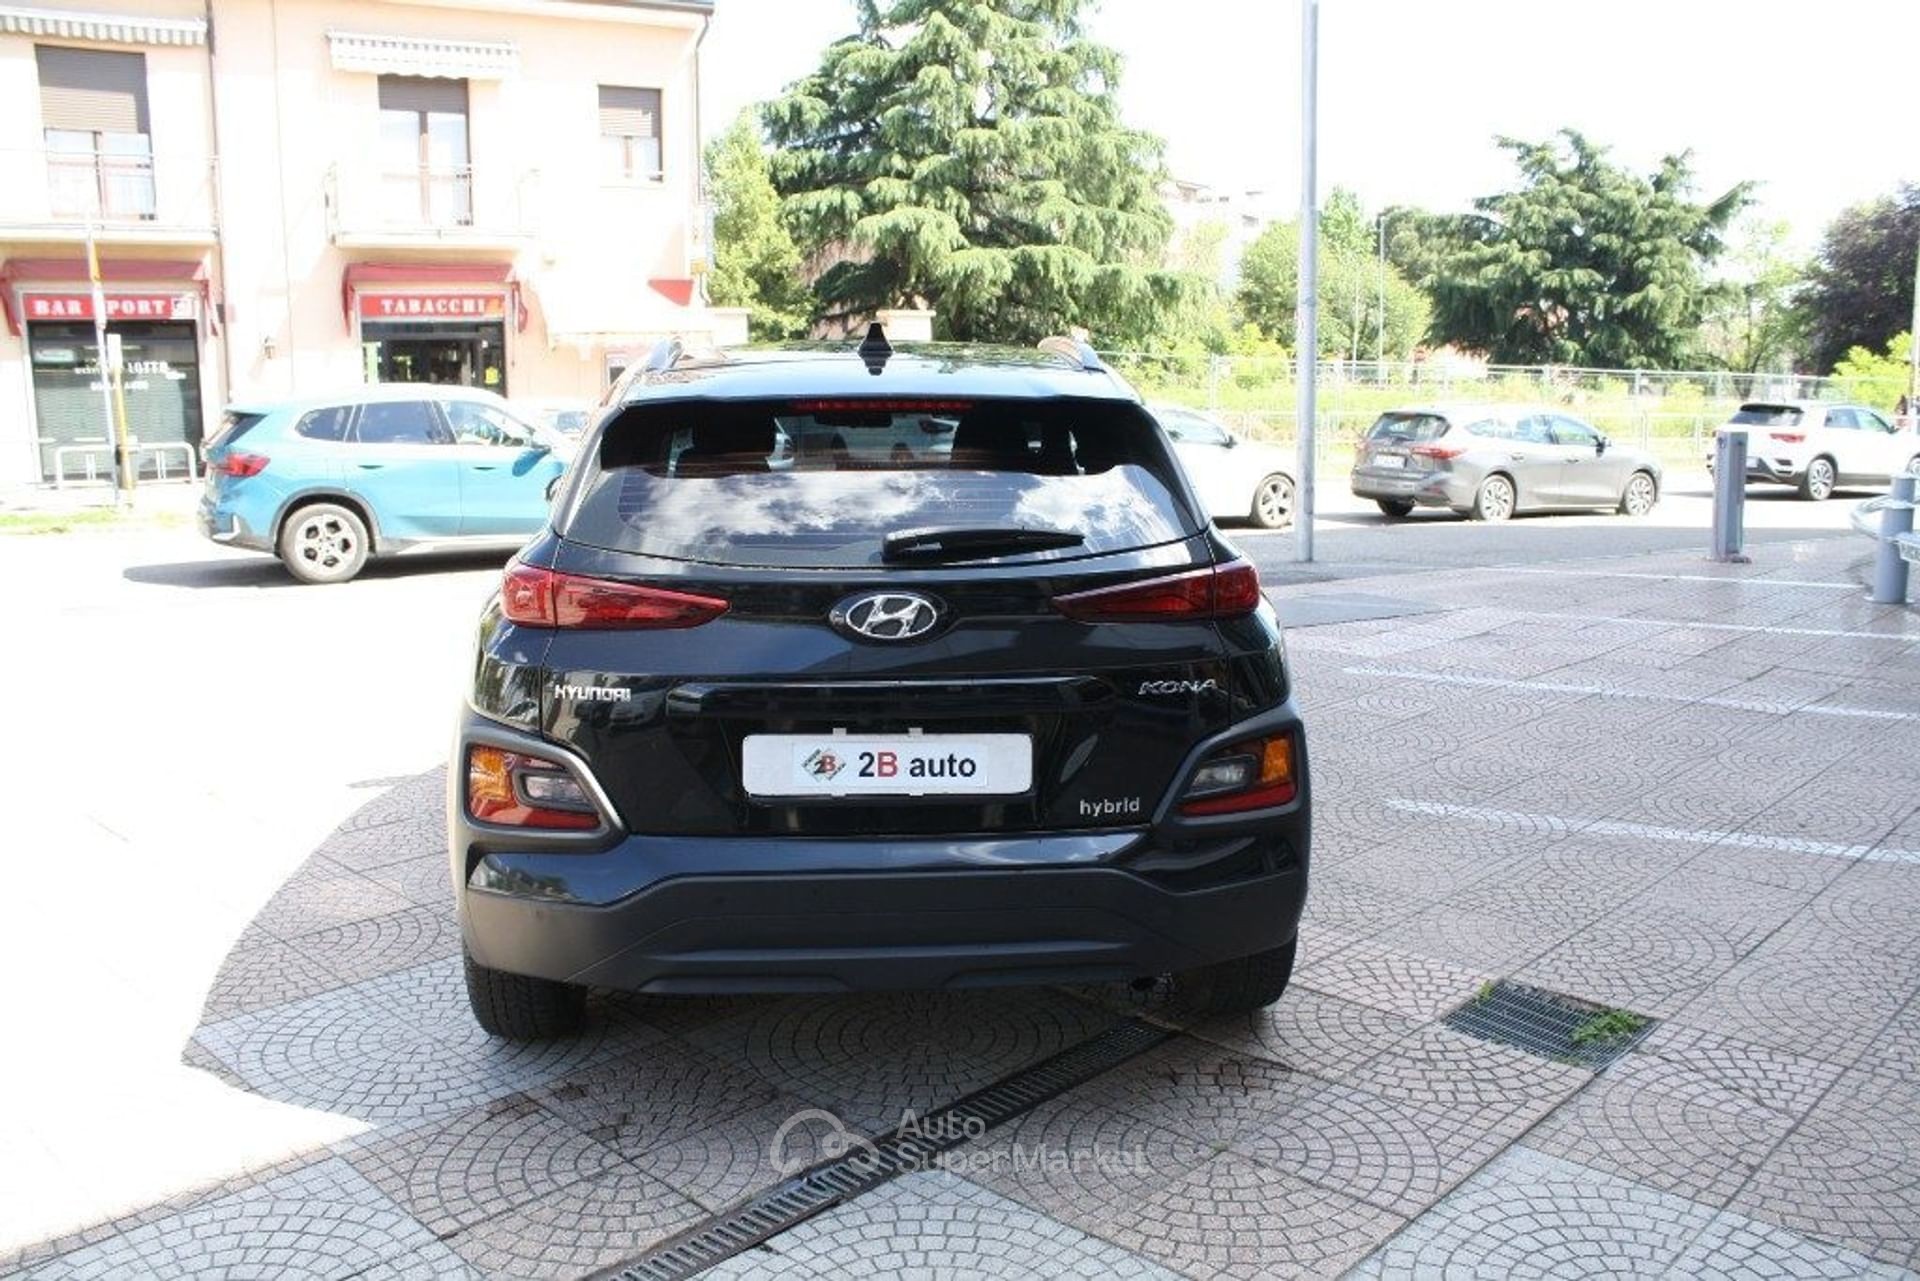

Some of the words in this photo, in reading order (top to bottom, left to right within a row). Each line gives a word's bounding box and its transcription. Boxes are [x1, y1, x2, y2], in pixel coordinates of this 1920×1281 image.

[33, 300, 82, 316] BAR
[98, 299, 166, 316] PORT
[381, 298, 485, 314] TABACCHI
[554, 684, 632, 702] HYUNDAI
[1138, 679, 1219, 695] KONA
[858, 751, 898, 777] 2B
[909, 753, 976, 777] auto
[1079, 797, 1140, 817] hybrid
